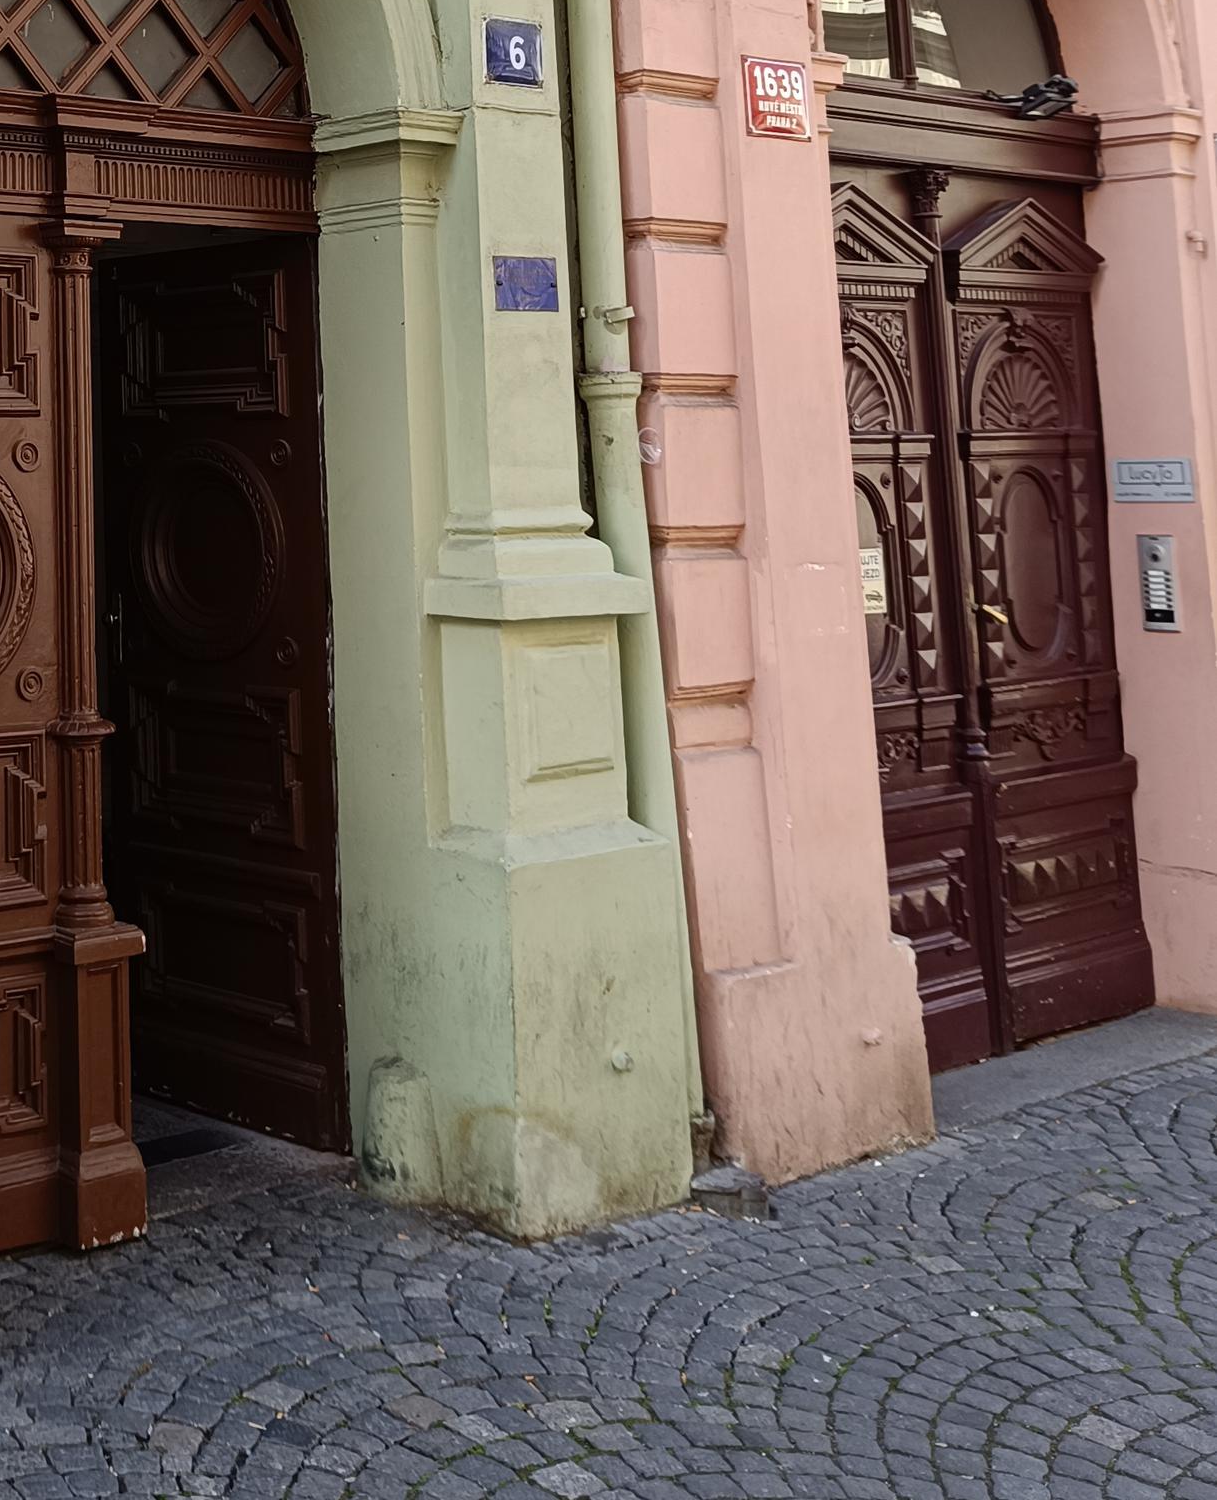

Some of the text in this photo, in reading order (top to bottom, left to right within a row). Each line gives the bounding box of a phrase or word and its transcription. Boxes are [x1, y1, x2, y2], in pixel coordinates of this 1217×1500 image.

[509, 35, 526, 70] 6
[753, 66, 803, 100] 1639
[766, 115, 790, 128] PRAHA
